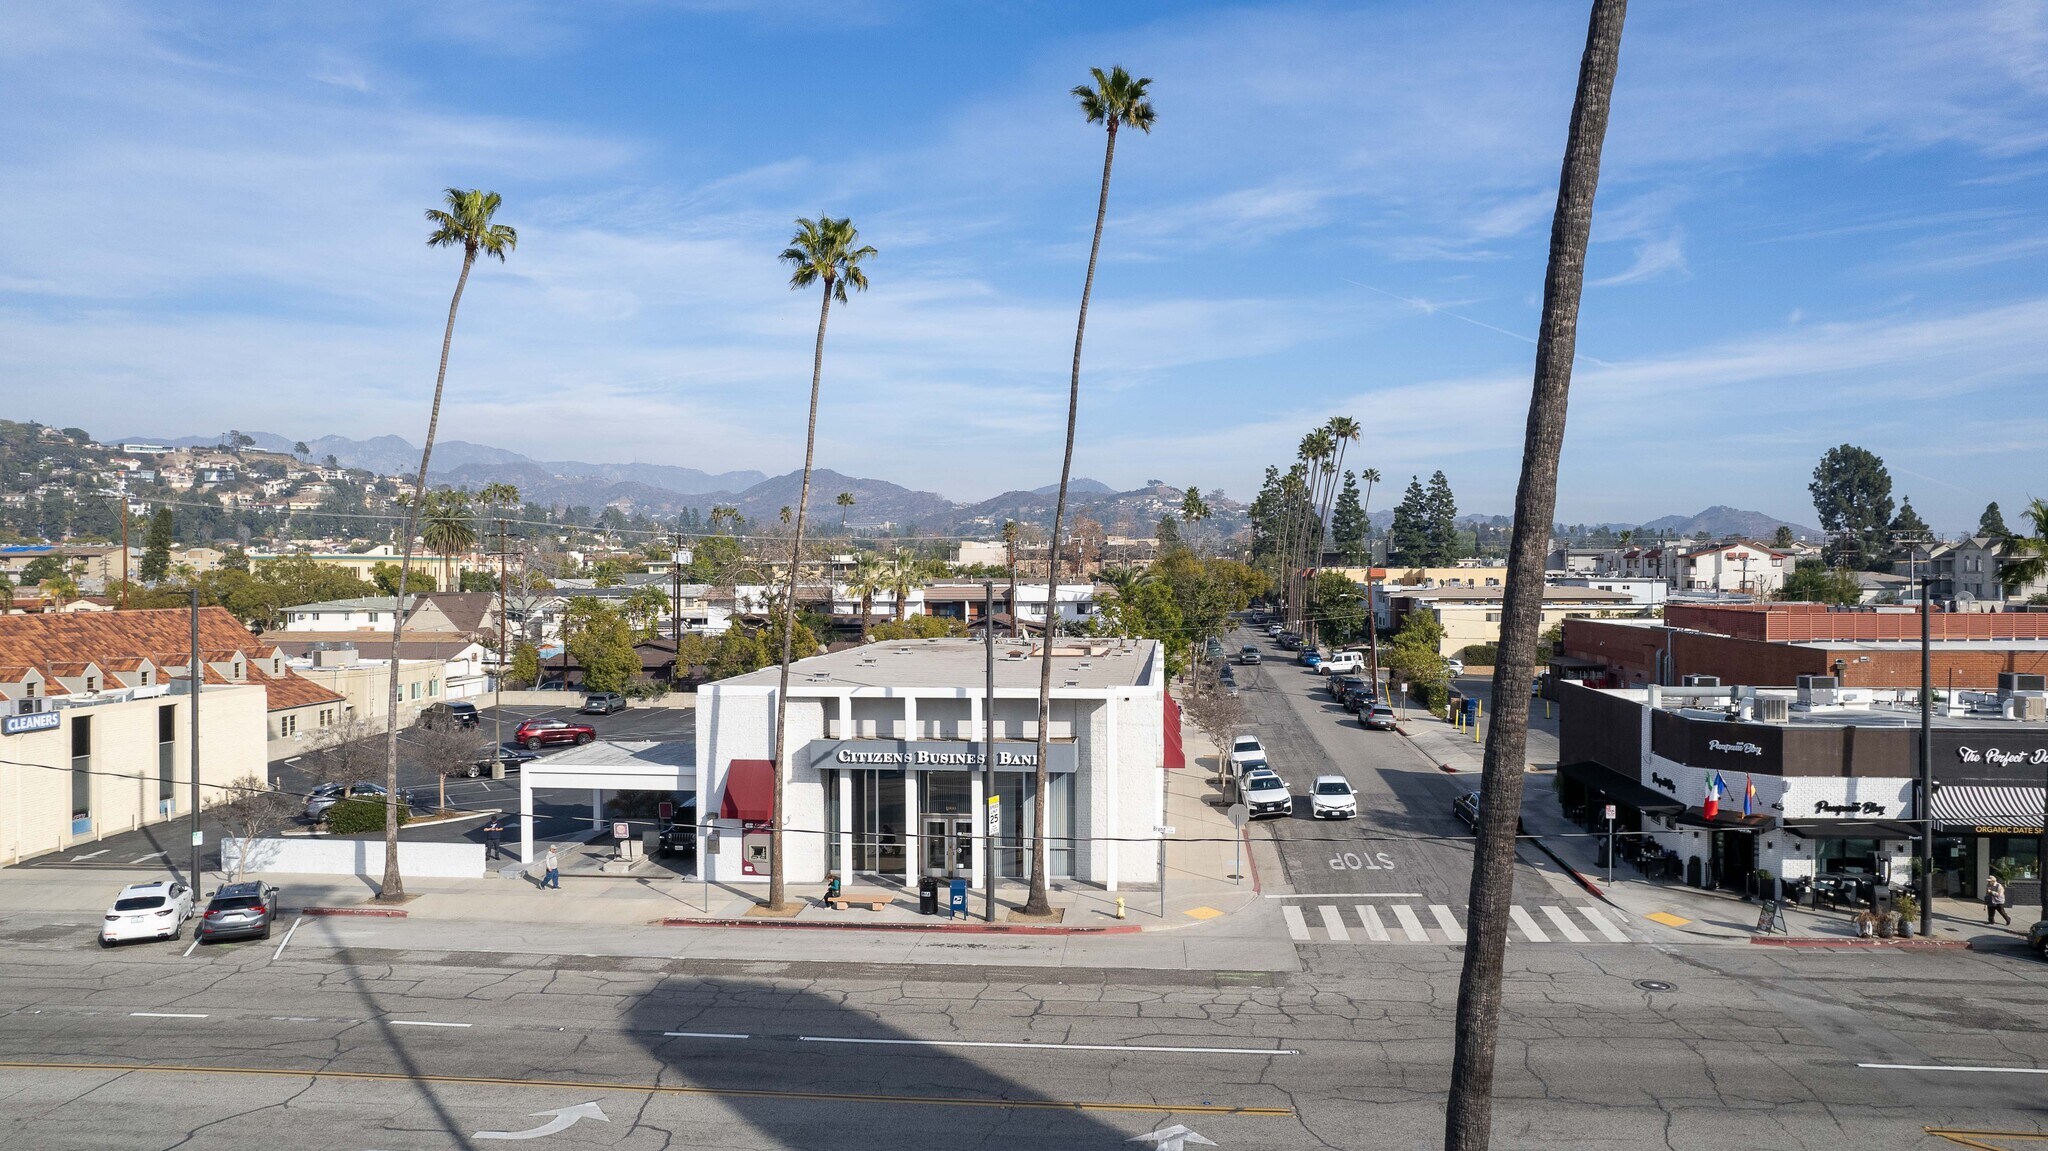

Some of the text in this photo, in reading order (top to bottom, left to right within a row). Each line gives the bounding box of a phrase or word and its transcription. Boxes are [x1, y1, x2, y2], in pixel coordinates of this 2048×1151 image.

[8, 714, 58, 731] CLEANERS
[838, 749, 912, 763] CITIZENS
[917, 750, 986, 765] BUSINES
[1959, 746, 1981, 763] The
[1985, 748, 2028, 767] Perfect
[990, 813, 999, 824] 25
[1975, 826, 2012, 834] ORGANIC
[2013, 826, 2033, 834] DATE
[1329, 852, 1395, 870] STOP
